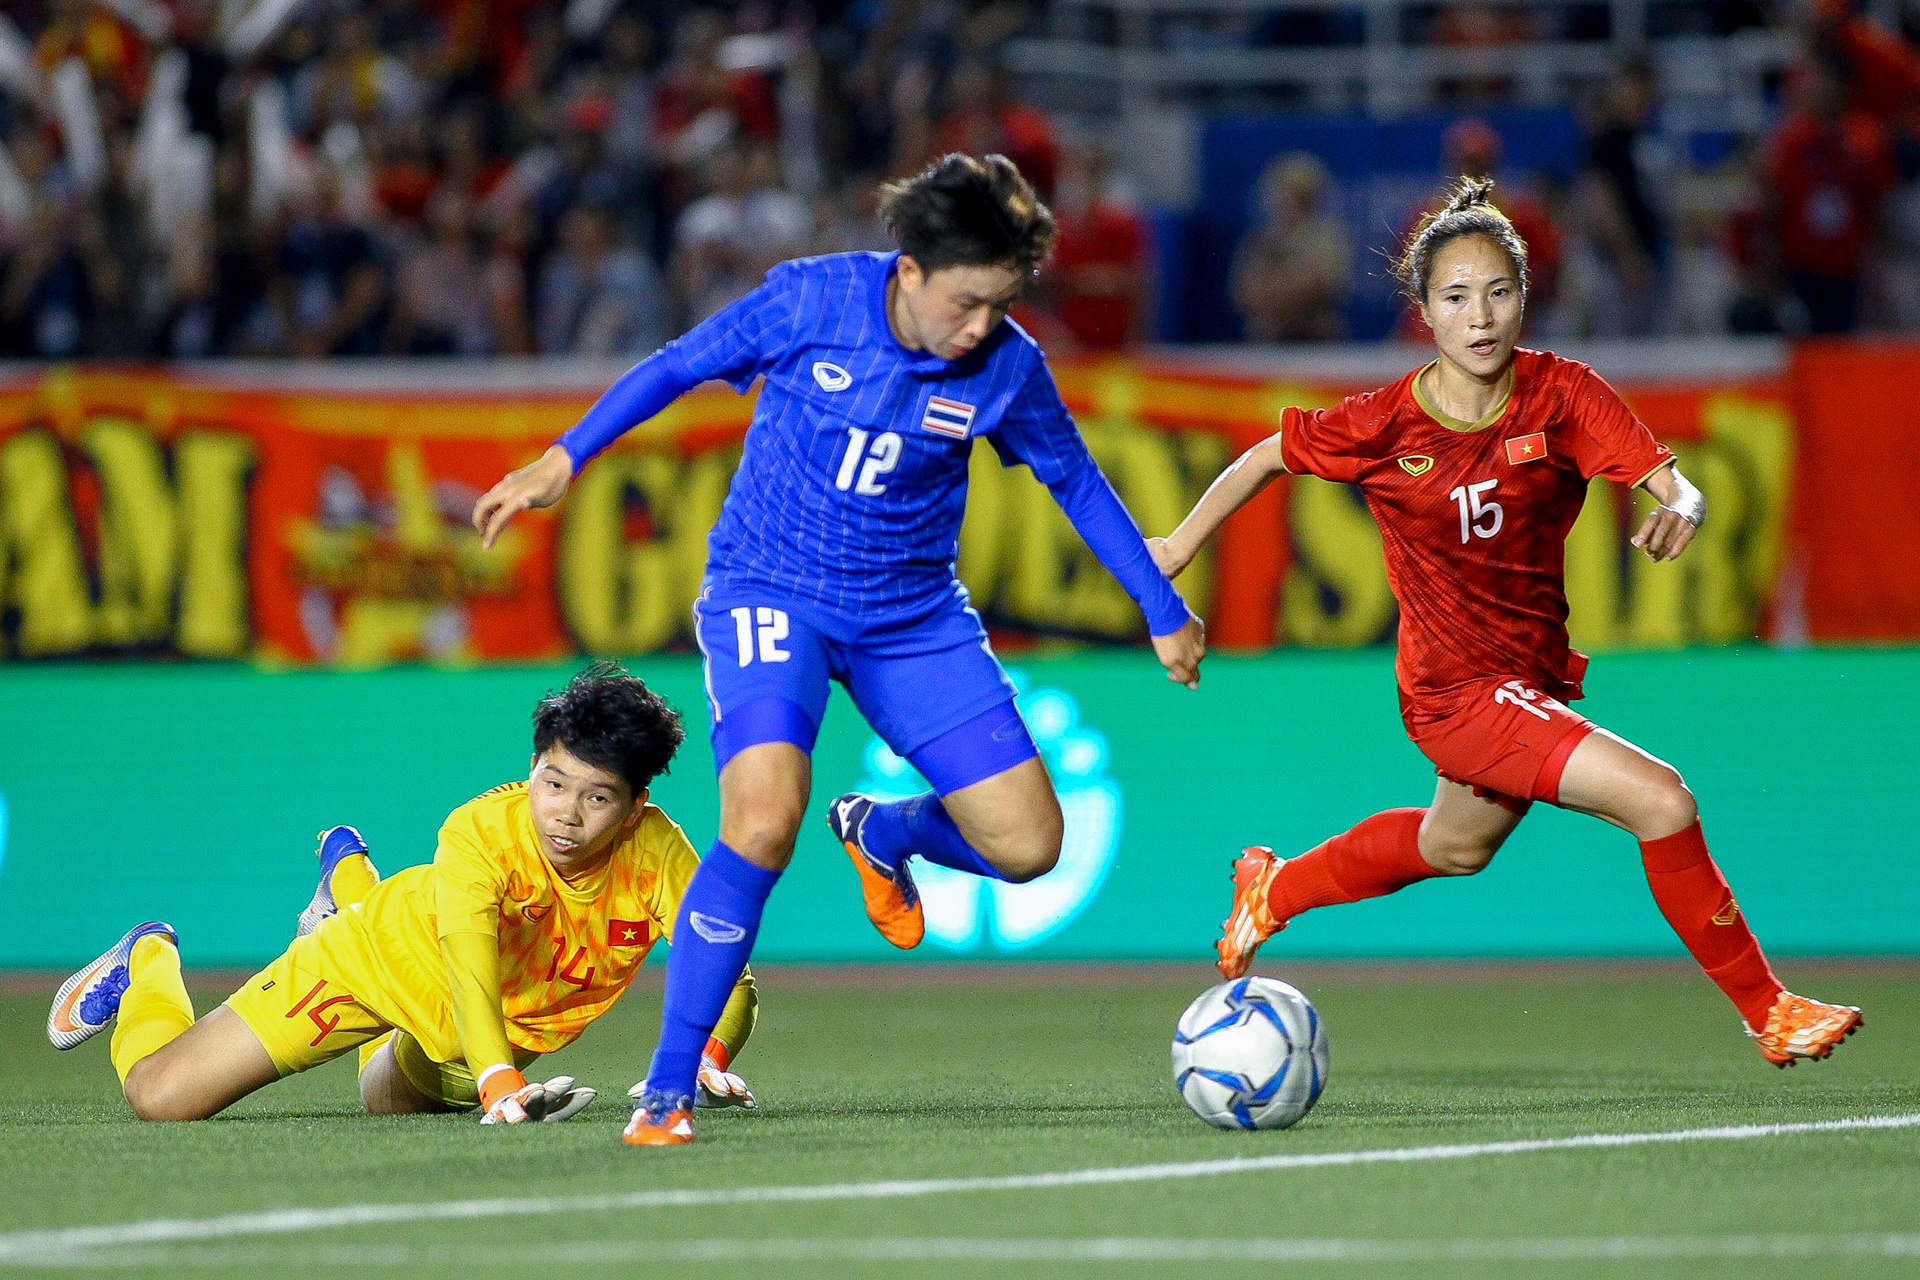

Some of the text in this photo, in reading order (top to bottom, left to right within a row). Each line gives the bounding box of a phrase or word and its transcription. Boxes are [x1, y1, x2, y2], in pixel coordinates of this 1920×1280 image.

[835, 426, 904, 496] 12
[1450, 478, 1504, 545] 15
[731, 606, 792, 668] 12
[1494, 680, 1564, 721] 15
[545, 936, 596, 992] 14
[284, 979, 354, 1046] 14
